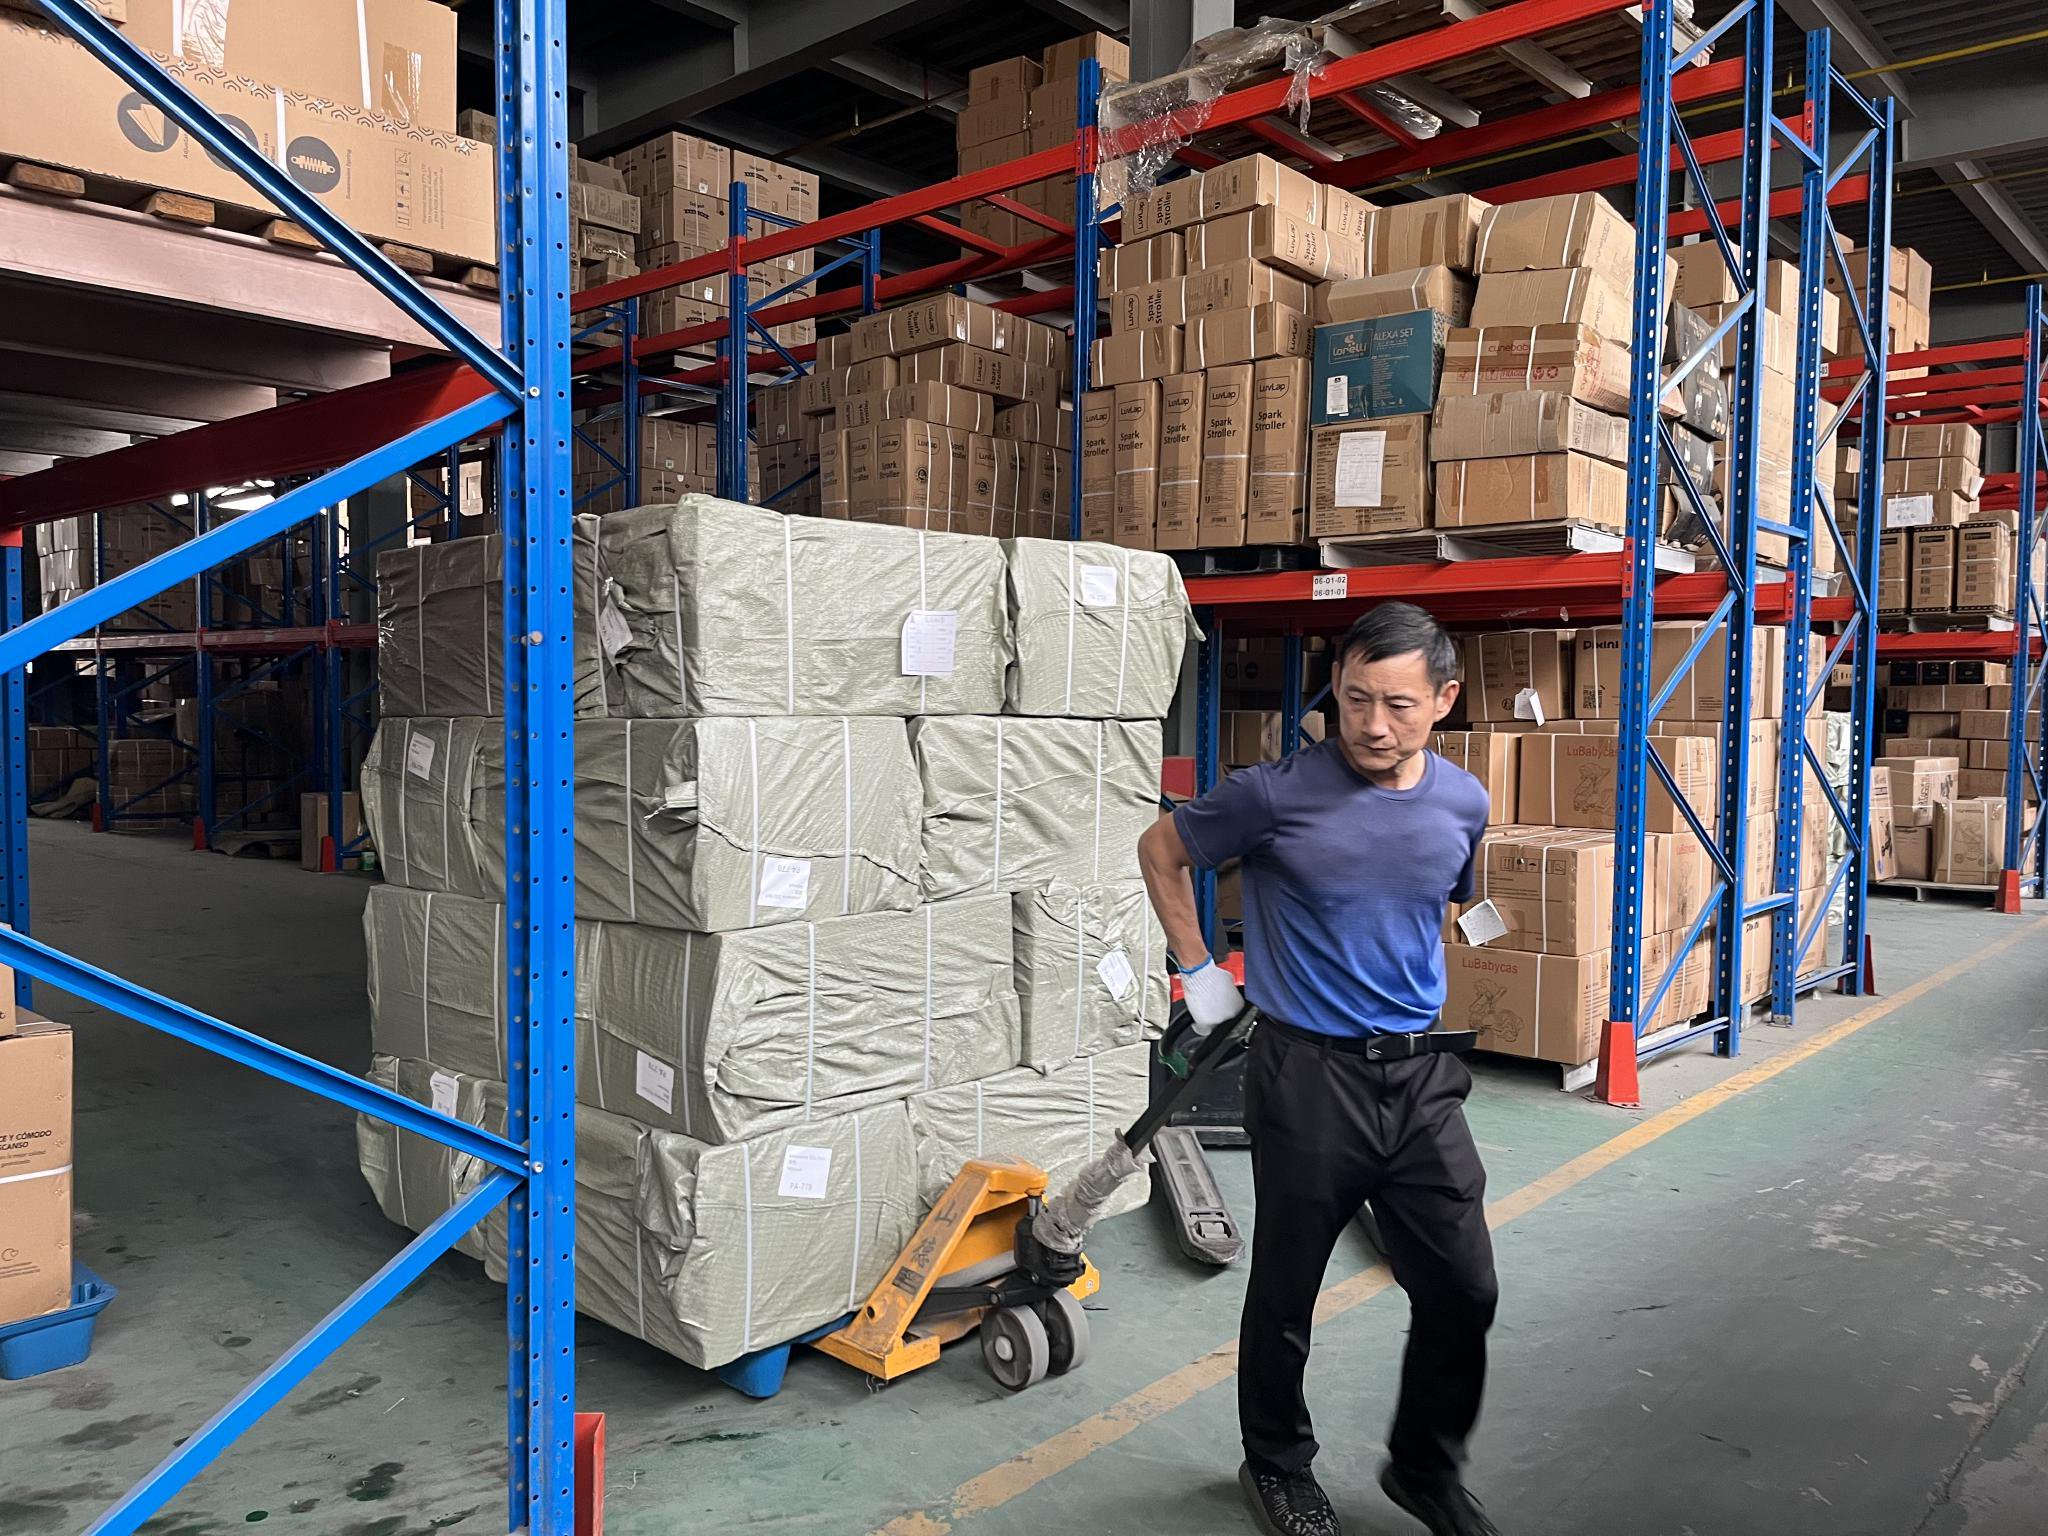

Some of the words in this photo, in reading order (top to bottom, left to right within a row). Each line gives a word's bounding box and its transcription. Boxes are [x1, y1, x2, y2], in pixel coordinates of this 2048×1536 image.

[1164, 191, 1172, 226] Stroller
[1138, 201, 1146, 230] LuvLap
[1341, 201, 1349, 231] LuvLap
[1355, 210, 1364, 236] Spark
[1309, 232, 1317, 266] Stroller
[1155, 289, 1163, 324] Stroller
[1373, 329, 1398, 341] ALEXA
[1400, 328, 1414, 338] SET
[1304, 327, 1312, 356] Spark
[1259, 382, 1286, 393] LuvLap
[1212, 390, 1236, 401] LuvLap
[1168, 397, 1190, 408] LuvLap
[1120, 405, 1142, 415] LuvLap
[1258, 409, 1283, 421] Spark
[1085, 413, 1108, 423] LuvLap
[1210, 417, 1233, 428] Spark
[1166, 423, 1187, 435] Spark
[1255, 421, 1286, 432] Stroller
[1120, 430, 1140, 440] Spark
[1207, 428, 1238, 439] Stroller
[1085, 438, 1106, 448] Spark
[1163, 435, 1191, 445] Stroller
[1118, 441, 1143, 452] Stroller
[1083, 448, 1109, 458] Stroller
[1315, 576, 1346, 585] 06-01-02
[1314, 589, 1345, 597] 06-01-01
[1462, 958, 1519, 974] LuBabycas
[16, 1130, 52, 1141] CÓMODO
